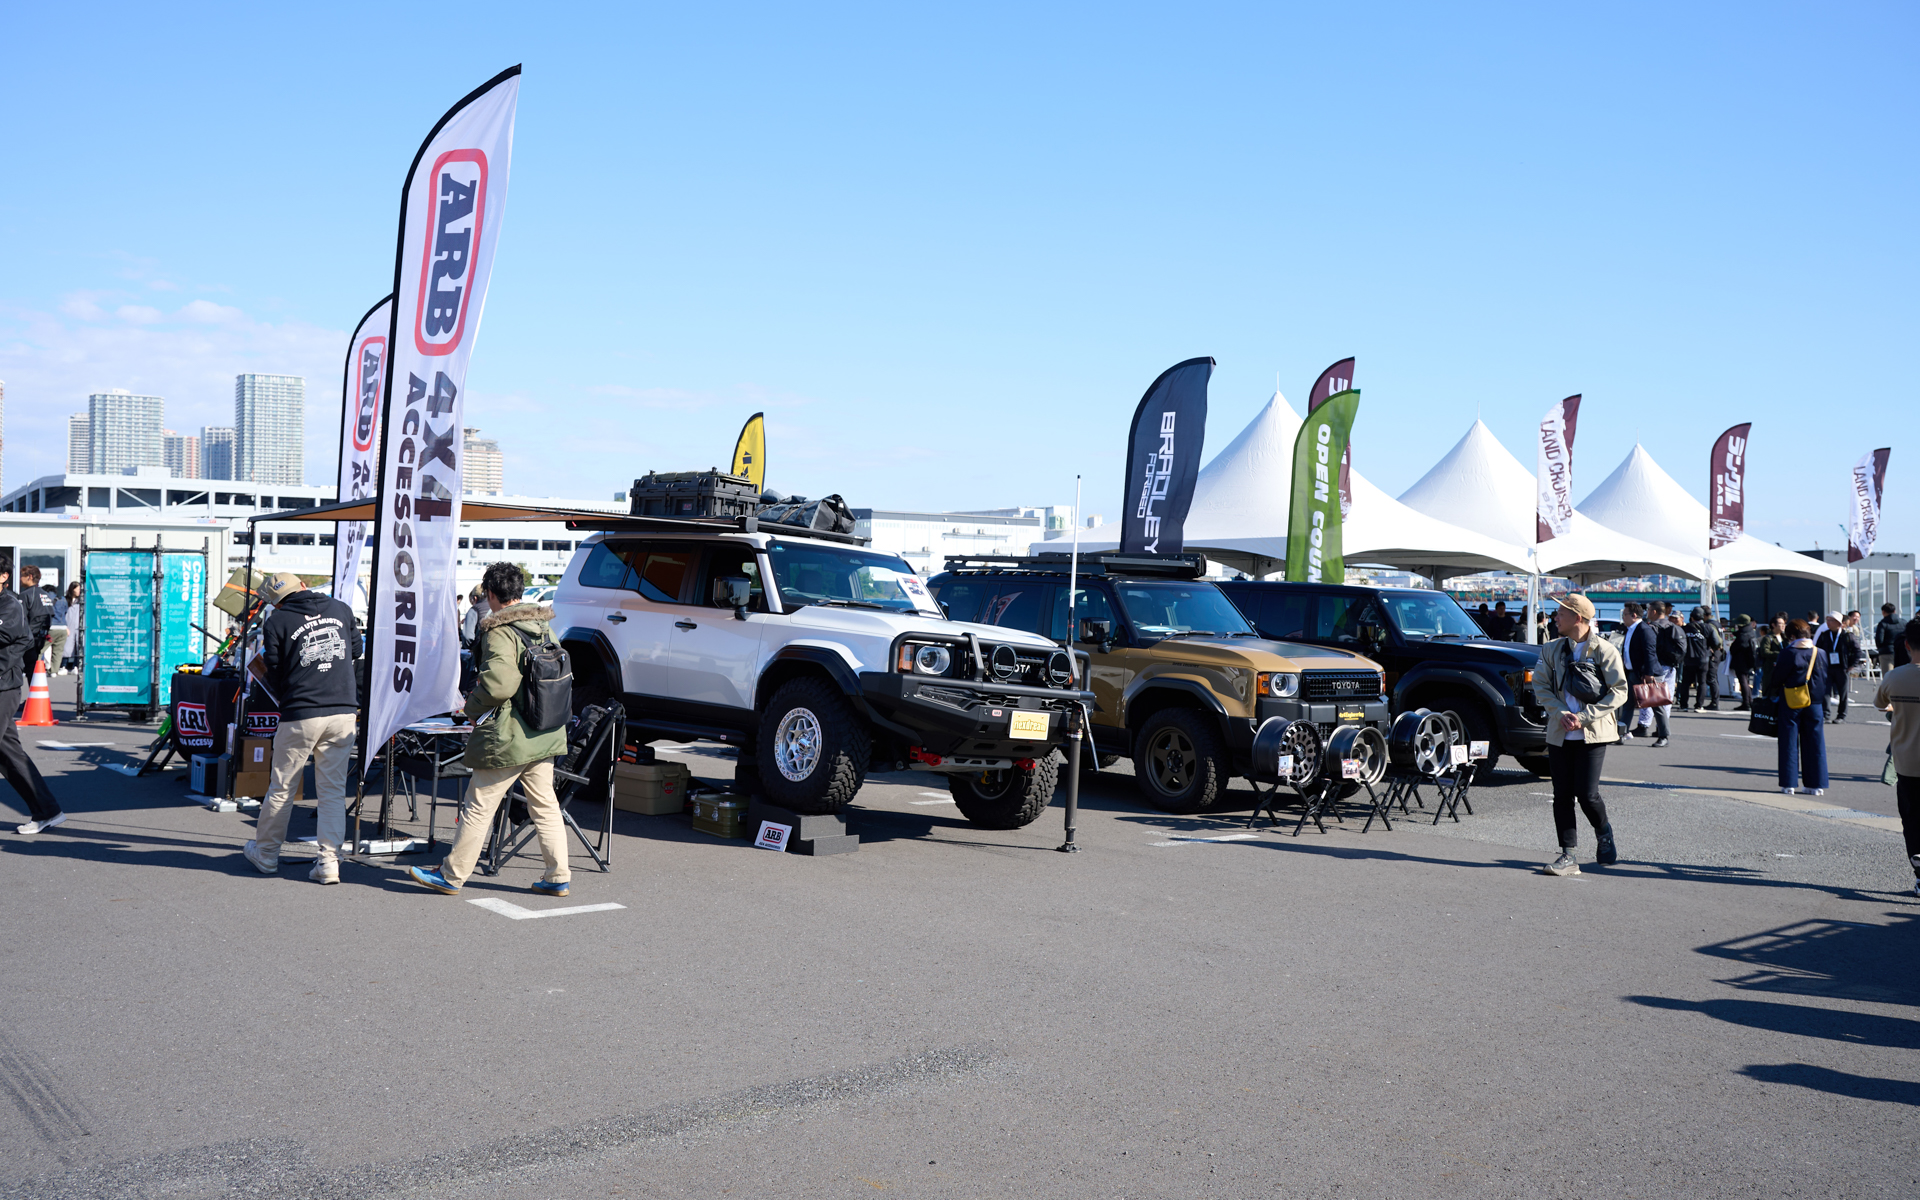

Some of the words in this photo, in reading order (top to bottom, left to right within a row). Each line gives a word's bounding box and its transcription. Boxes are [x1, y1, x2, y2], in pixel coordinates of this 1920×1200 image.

[425, 173, 477, 337] ARB
[358, 349, 382, 441] ARB
[415, 371, 458, 522] 4X4
[1314, 423, 1331, 503] OPEN
[1540, 420, 1562, 461] LAND
[1724, 435, 1746, 507] ランクル
[1136, 452, 1158, 519] FORGED
[1144, 411, 1176, 554] BRADLEY
[1548, 462, 1573, 522] CRUISER
[1716, 474, 1724, 515] BASE
[1853, 465, 1869, 498] LAND
[393, 371, 428, 694] ACCESSORIES
[1307, 510, 1325, 583] COUN
[181, 560, 192, 602] Zone
[1331, 681, 1360, 690] TOYOTA
[246, 716, 279, 728] ARB
[765, 829, 782, 841] ARB
